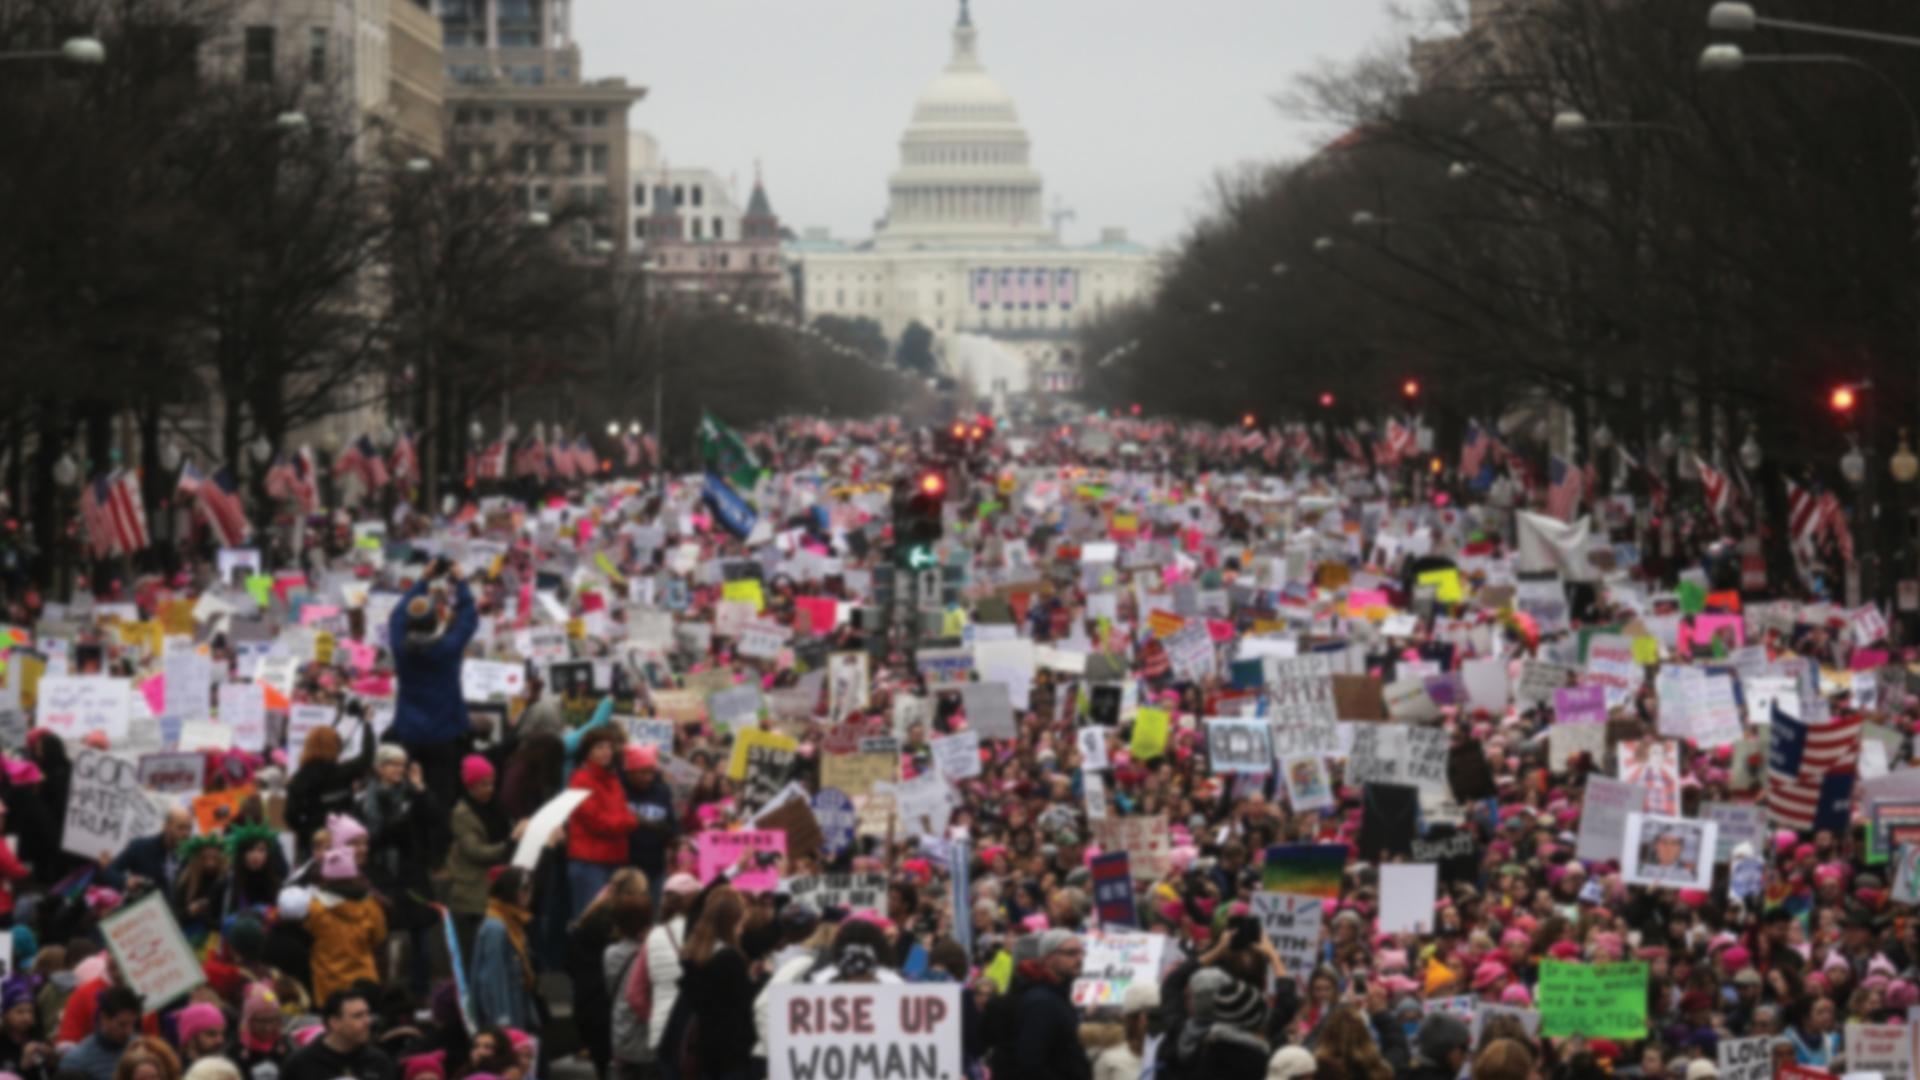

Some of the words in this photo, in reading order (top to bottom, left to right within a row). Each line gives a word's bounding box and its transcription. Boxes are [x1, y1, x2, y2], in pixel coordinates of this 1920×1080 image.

[75, 750, 137, 793] GOD
[1270, 936, 1307, 950] ITH
[787, 995, 875, 1035] RISE
[898, 995, 947, 1034] UP
[787, 1041, 951, 1080] WOMAN.
[1727, 1038, 1769, 1065] LOVE
